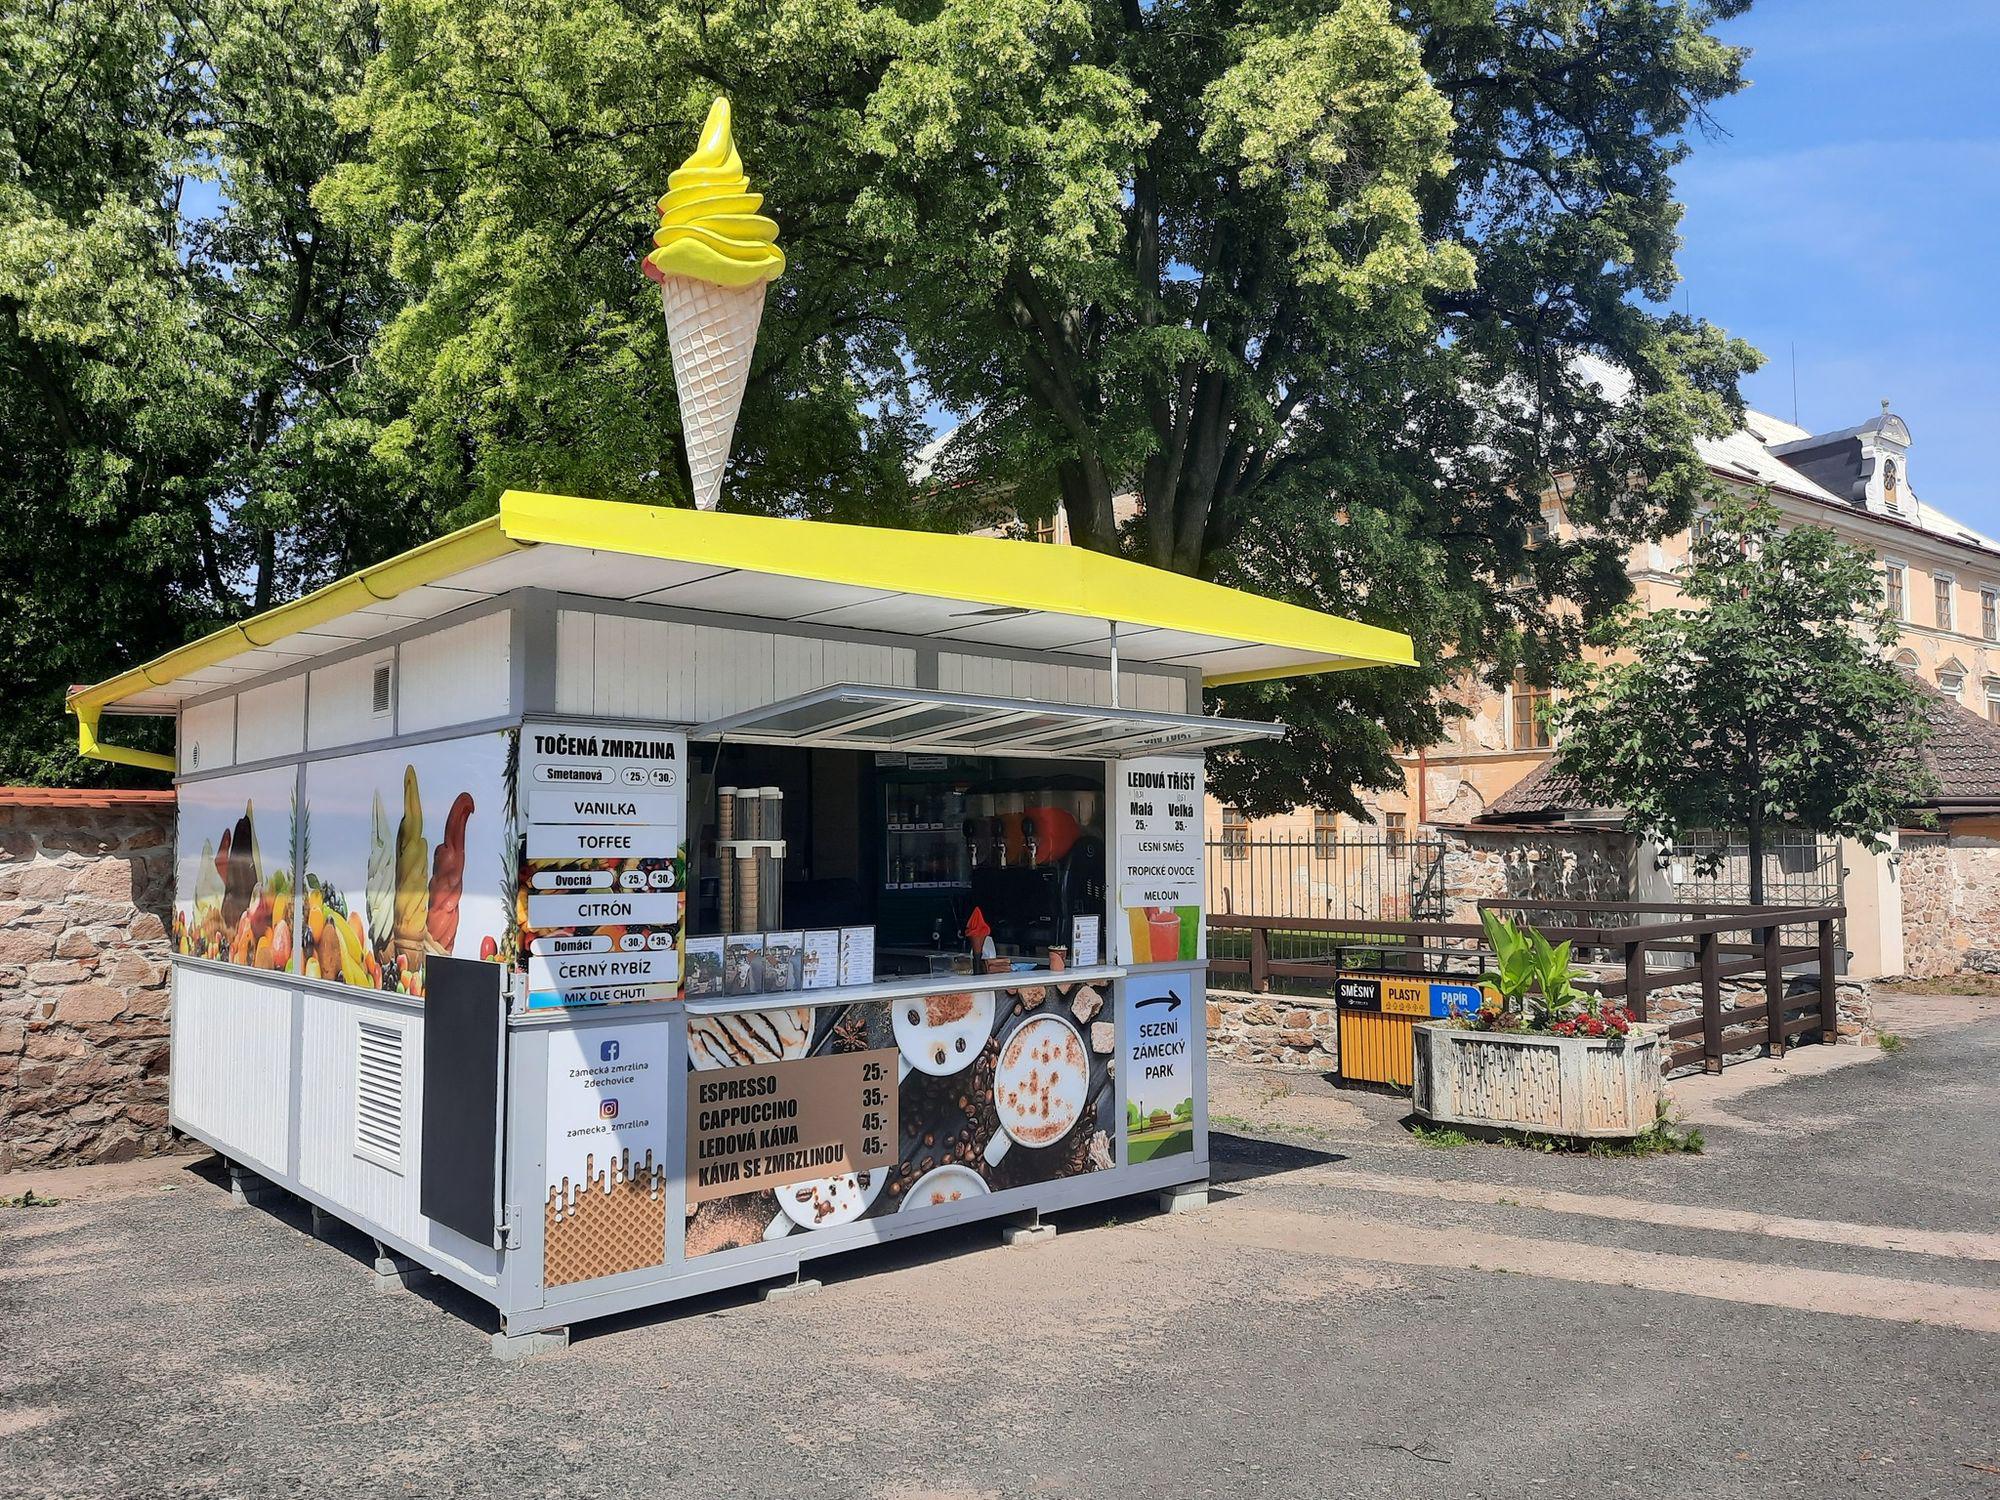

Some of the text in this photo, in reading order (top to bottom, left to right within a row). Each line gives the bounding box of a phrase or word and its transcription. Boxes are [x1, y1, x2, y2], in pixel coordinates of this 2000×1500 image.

[535, 734, 675, 760] TOČENÁ ZMRZLINA
[547, 768, 603, 781] Smetanová
[1127, 771, 1195, 790] LEDOVÁ TŘÍŠŤ
[574, 802, 637, 815] VANILKA
[1130, 802, 1194, 817] Malá Velká
[1135, 820, 1188, 831] 25,- 35,-
[577, 836, 631, 849] TOFFEE
[1138, 841, 1184, 852] LESNÍ SMĚS
[1128, 864, 1195, 876] TROPICKÉ OVOCE
[555, 874, 592, 886] Ovocná
[1144, 891, 1179, 900] MELOUN
[578, 900, 632, 917] CITRÓN
[554, 940, 592, 952] Domácí
[559, 960, 651, 978] ČERNÝ RYBÍZ
[564, 988, 645, 1003] MIX DLE CHUTI
[1340, 984, 1375, 999] SMĚSNÝ
[1388, 988, 1421, 1002] PLASTY
[1441, 991, 1468, 1005] PAPÍR
[1139, 1018, 1178, 1038] SEZENÍ
[1133, 1039, 1186, 1060] ZÁMECKÝ
[611, 1062, 649, 1073] zmrzlina
[1145, 1064, 1174, 1079] PARK
[584, 1076, 635, 1089] Zdechovice
[699, 1063, 889, 1104] ESPRESSO 25,-
[699, 1088, 889, 1131] CAPPUCCINO 35,-
[567, 1120, 649, 1138] zamecka_zmrzlina
[699, 1112, 888, 1159] LEDOVÁ KÁVA 45,-
[698, 1136, 888, 1187] KÁVA SE ZMRZLINOU 45,-
